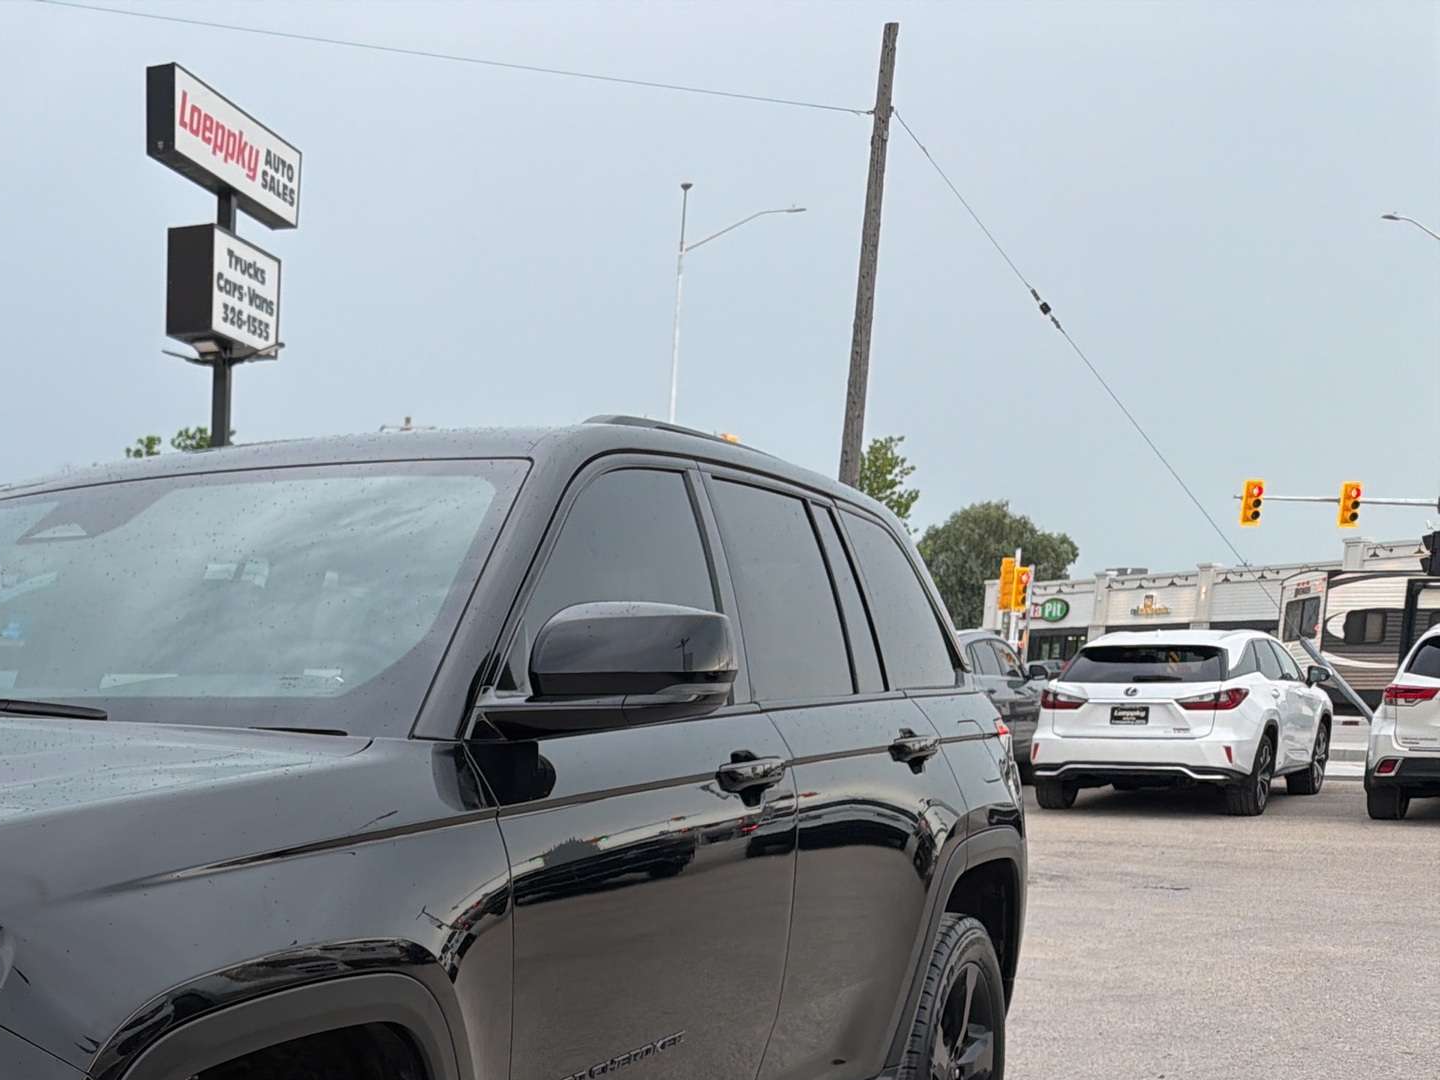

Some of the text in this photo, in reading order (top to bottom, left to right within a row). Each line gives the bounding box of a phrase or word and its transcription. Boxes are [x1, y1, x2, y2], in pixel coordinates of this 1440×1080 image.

[178, 89, 260, 182] Loeppky
[264, 148, 294, 183] AUTO
[261, 169, 295, 208] SALES
[227, 247, 266, 286] Trucks
[221, 302, 270, 342] 326-1555
[1044, 600, 1062, 617] Pit
